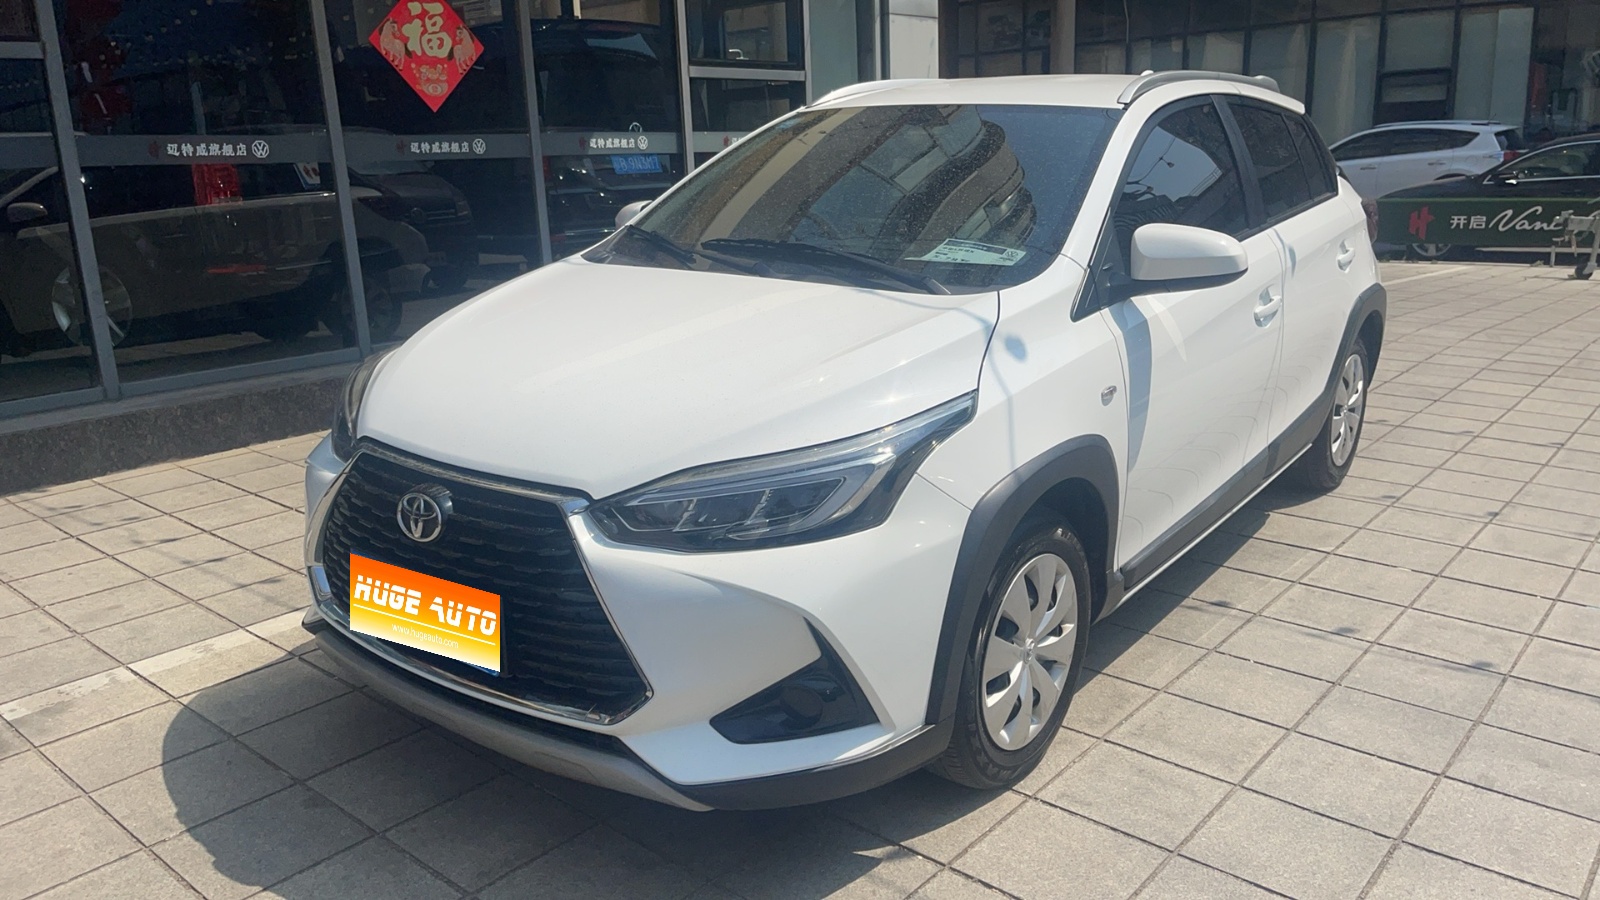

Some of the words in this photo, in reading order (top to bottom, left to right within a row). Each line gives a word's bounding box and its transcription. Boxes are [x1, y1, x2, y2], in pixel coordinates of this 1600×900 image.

[402, 2, 452, 57] 福
[167, 143, 247, 156] 迈特威旗舰店
[410, 142, 469, 153] 迈特威旗舰店
[1450, 215, 1486, 230] 开启
